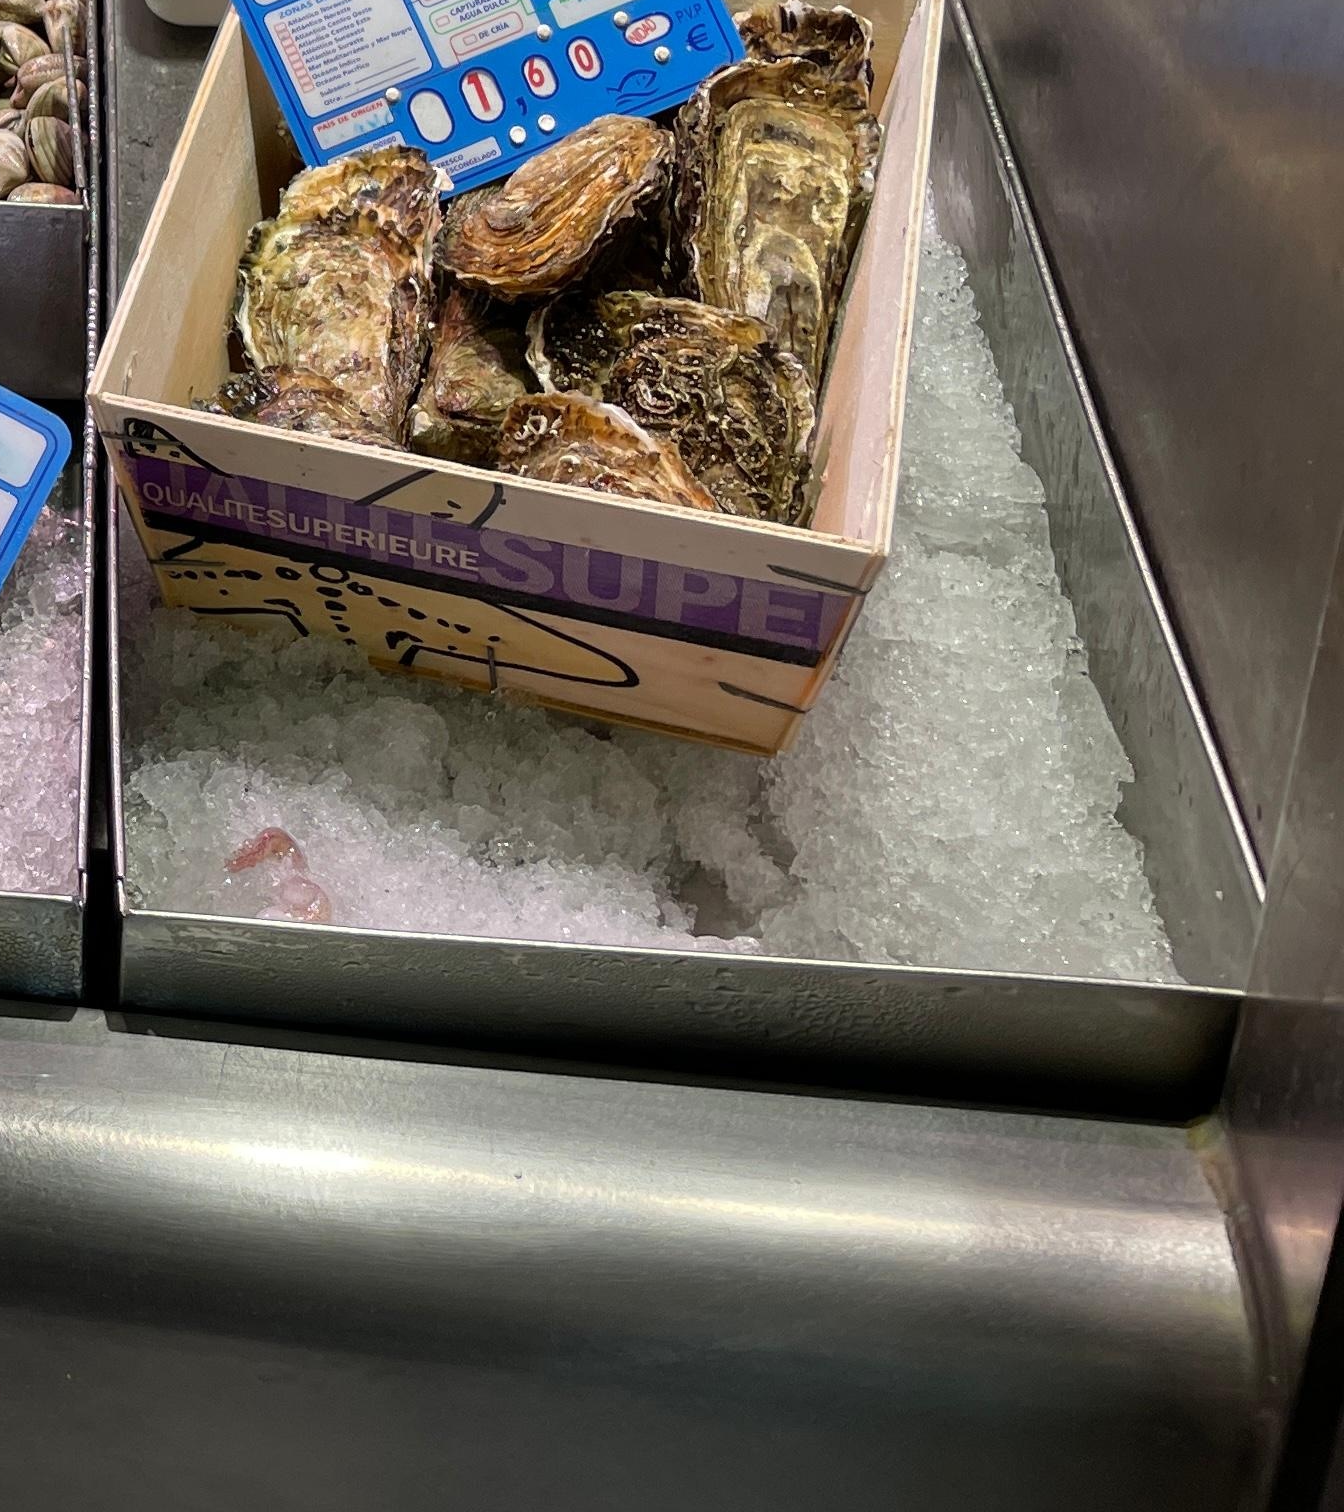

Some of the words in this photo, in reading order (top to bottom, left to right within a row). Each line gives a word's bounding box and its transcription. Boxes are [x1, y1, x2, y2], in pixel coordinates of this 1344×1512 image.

[278, 0, 313, 19] ZONAS
[457, 7, 481, 22] AGUA
[476, 28, 489, 39] DE
